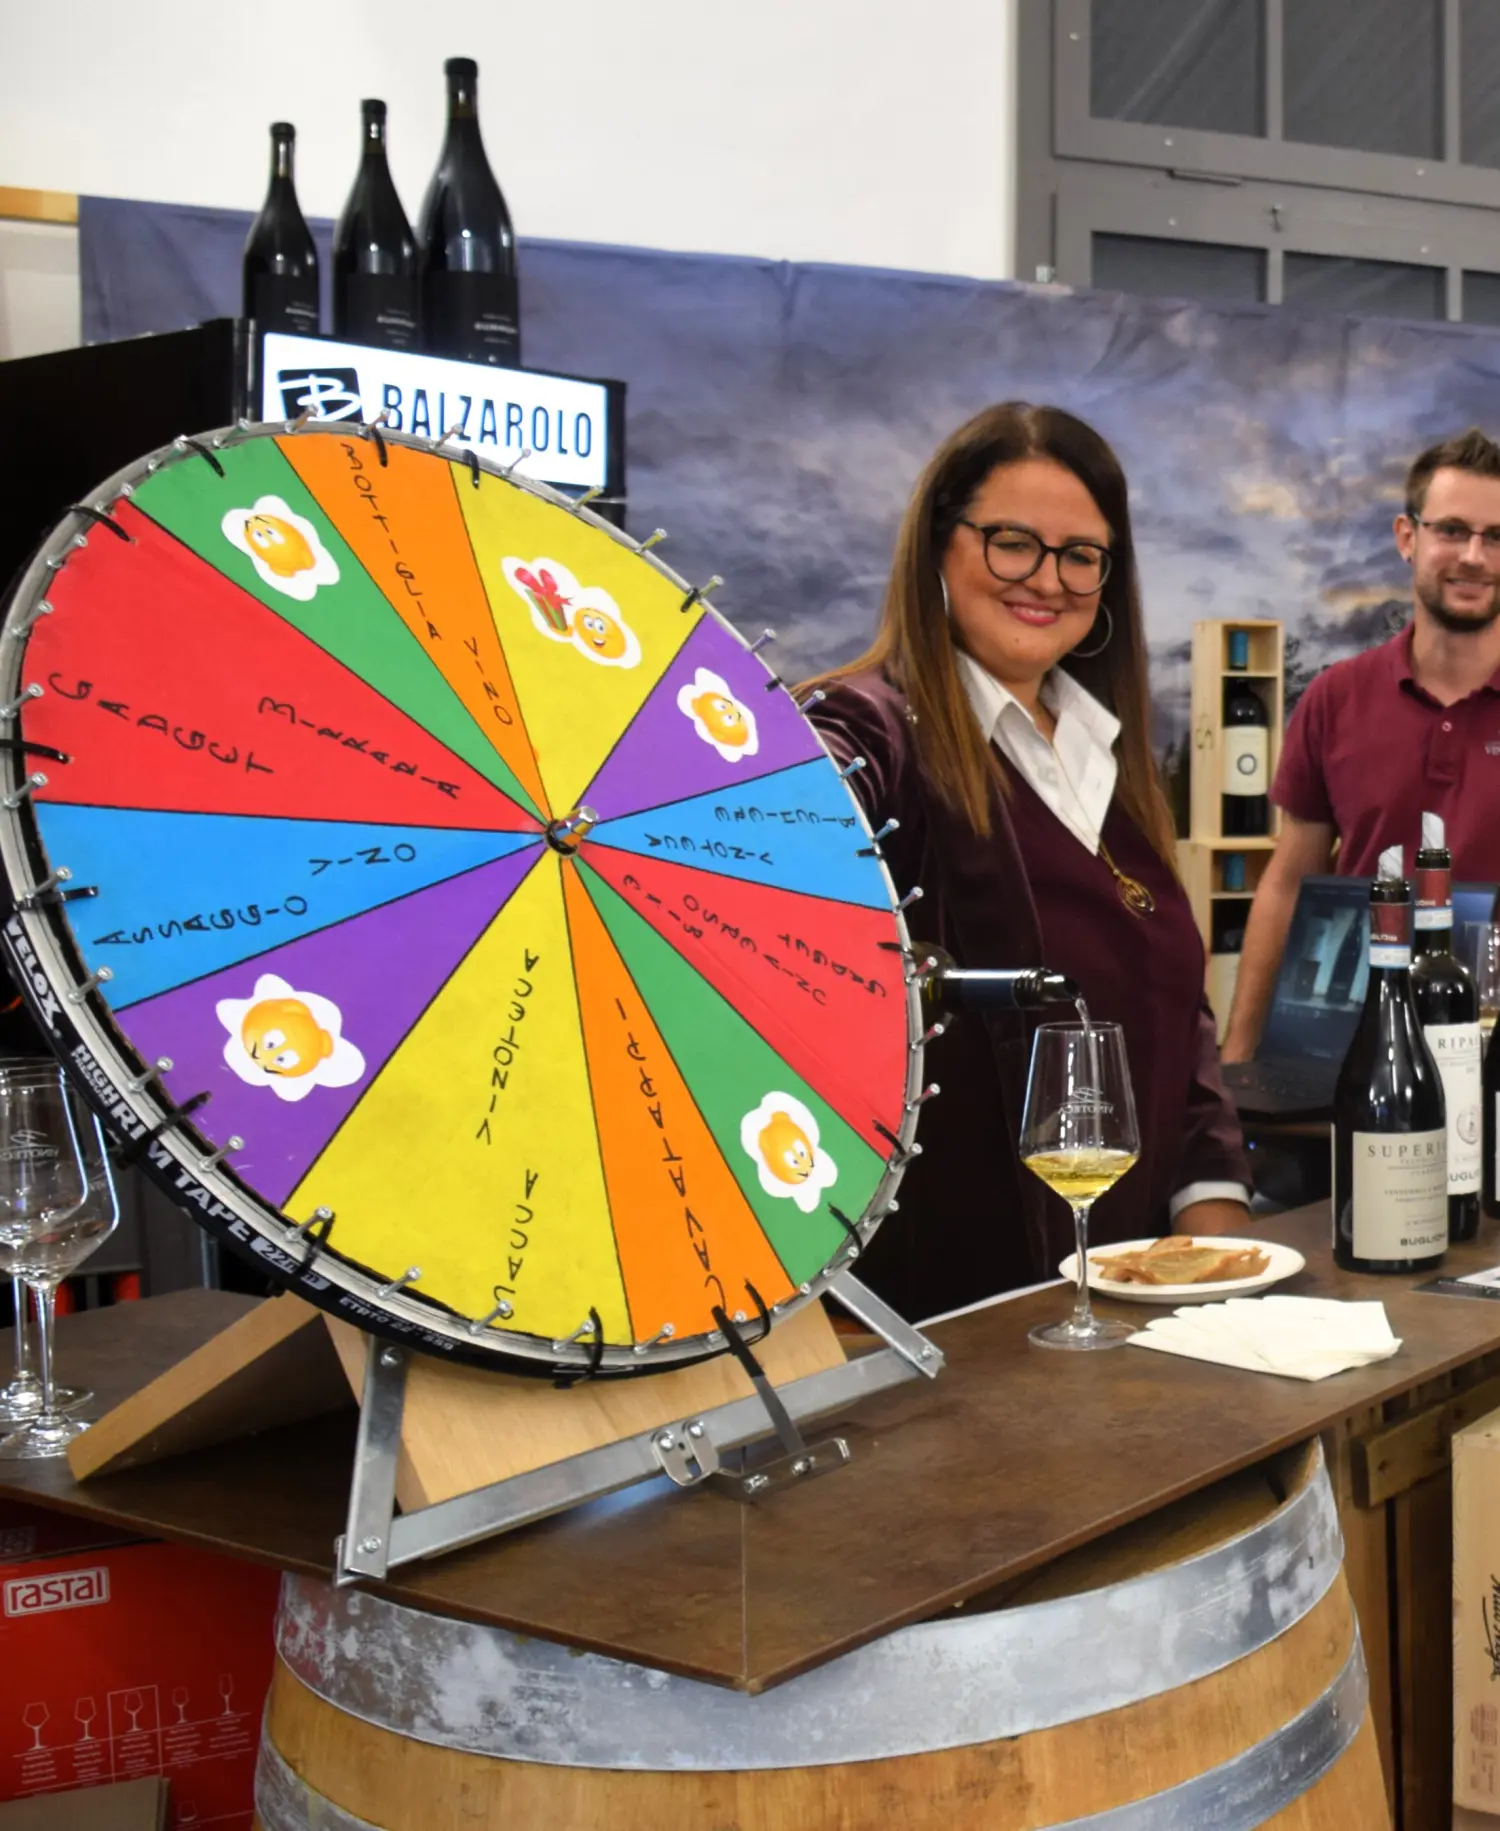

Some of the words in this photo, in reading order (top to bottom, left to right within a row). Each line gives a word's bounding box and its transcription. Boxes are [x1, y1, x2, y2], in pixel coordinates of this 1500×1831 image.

[383, 383, 593, 458] BALZAROLO
[48, 672, 274, 776] GADGET
[464, 637, 513, 726] VINO
[308, 843, 416, 876] VINO
[644, 833, 774, 865] VINOTECA
[715, 805, 858, 829] BICCHIERE
[93, 895, 308, 945] ASSAGGIO
[622, 874, 704, 939] BIKE
[683, 894, 829, 1006] UNIVERSO
[7, 914, 63, 1030] VELOX
[778, 932, 888, 1000] GADGET
[475, 948, 540, 1146] VINOTECA
[70, 1043, 121, 1105] HIGH
[174, 1166, 251, 1242] TAPE
[615, 997, 727, 1312] CAVATAPPI
[493, 1168, 539, 1321] SACCA
